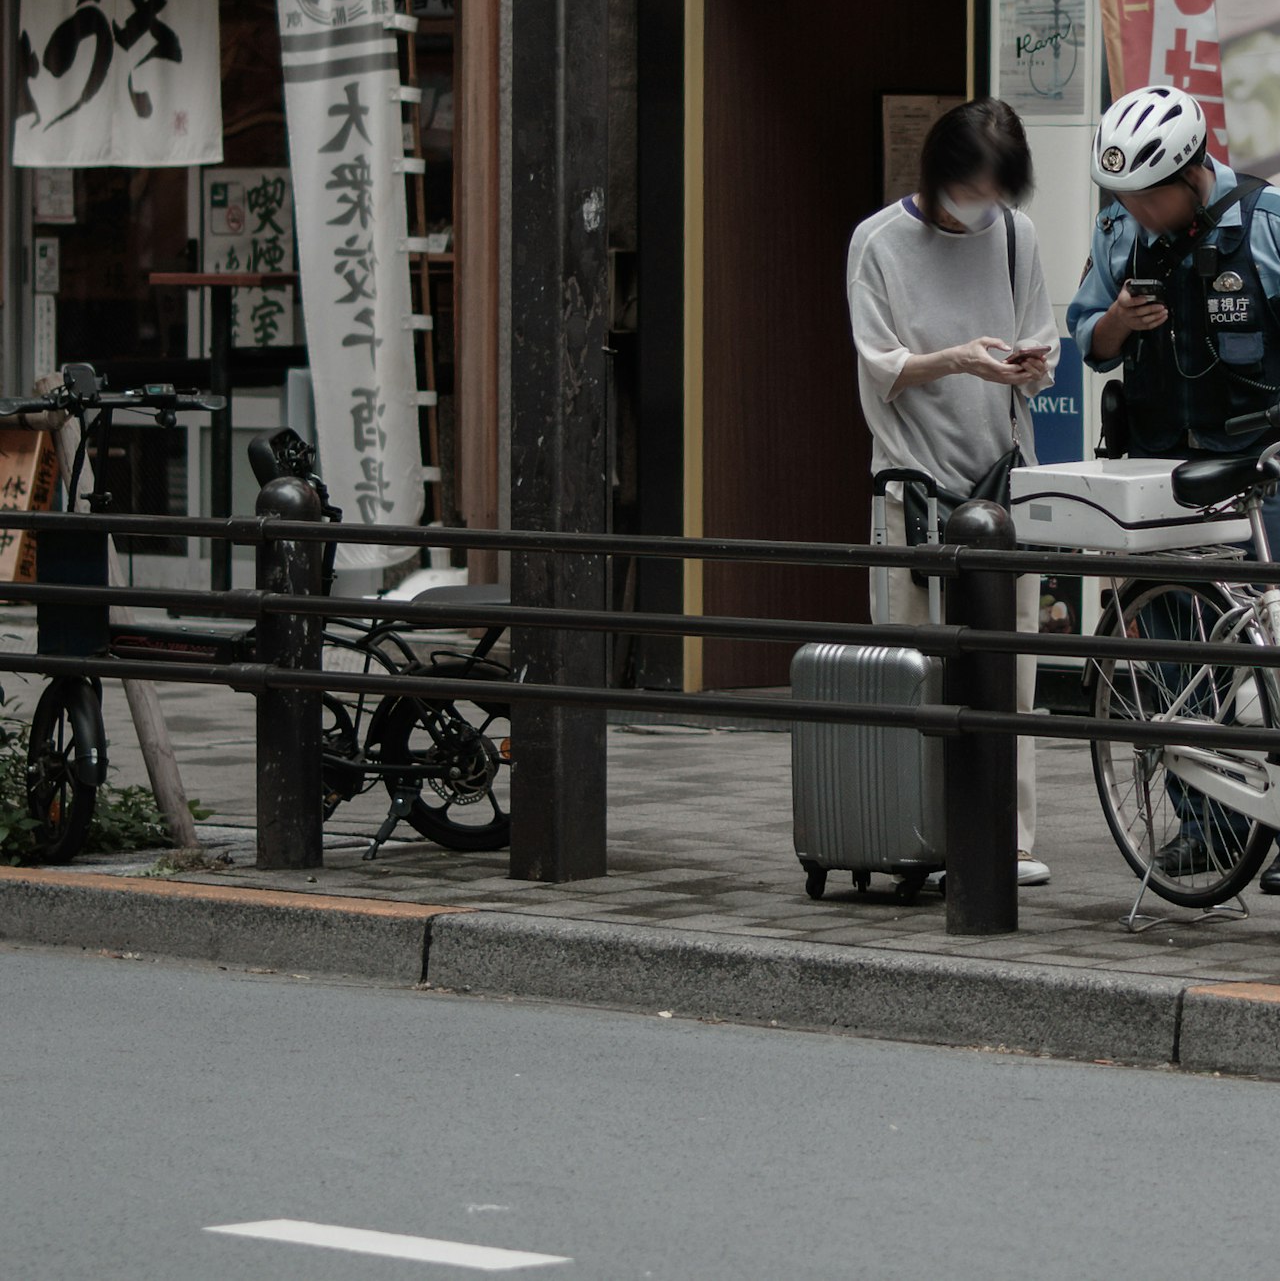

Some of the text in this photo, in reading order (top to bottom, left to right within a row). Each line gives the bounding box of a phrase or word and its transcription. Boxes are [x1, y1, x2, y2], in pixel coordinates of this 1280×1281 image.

[1207, 297, 1250, 313] 警視庁
[1210, 311, 1249, 323] POLICE
[1028, 395, 1079, 415] ARVEL
[0, 475, 27, 556] 休中
